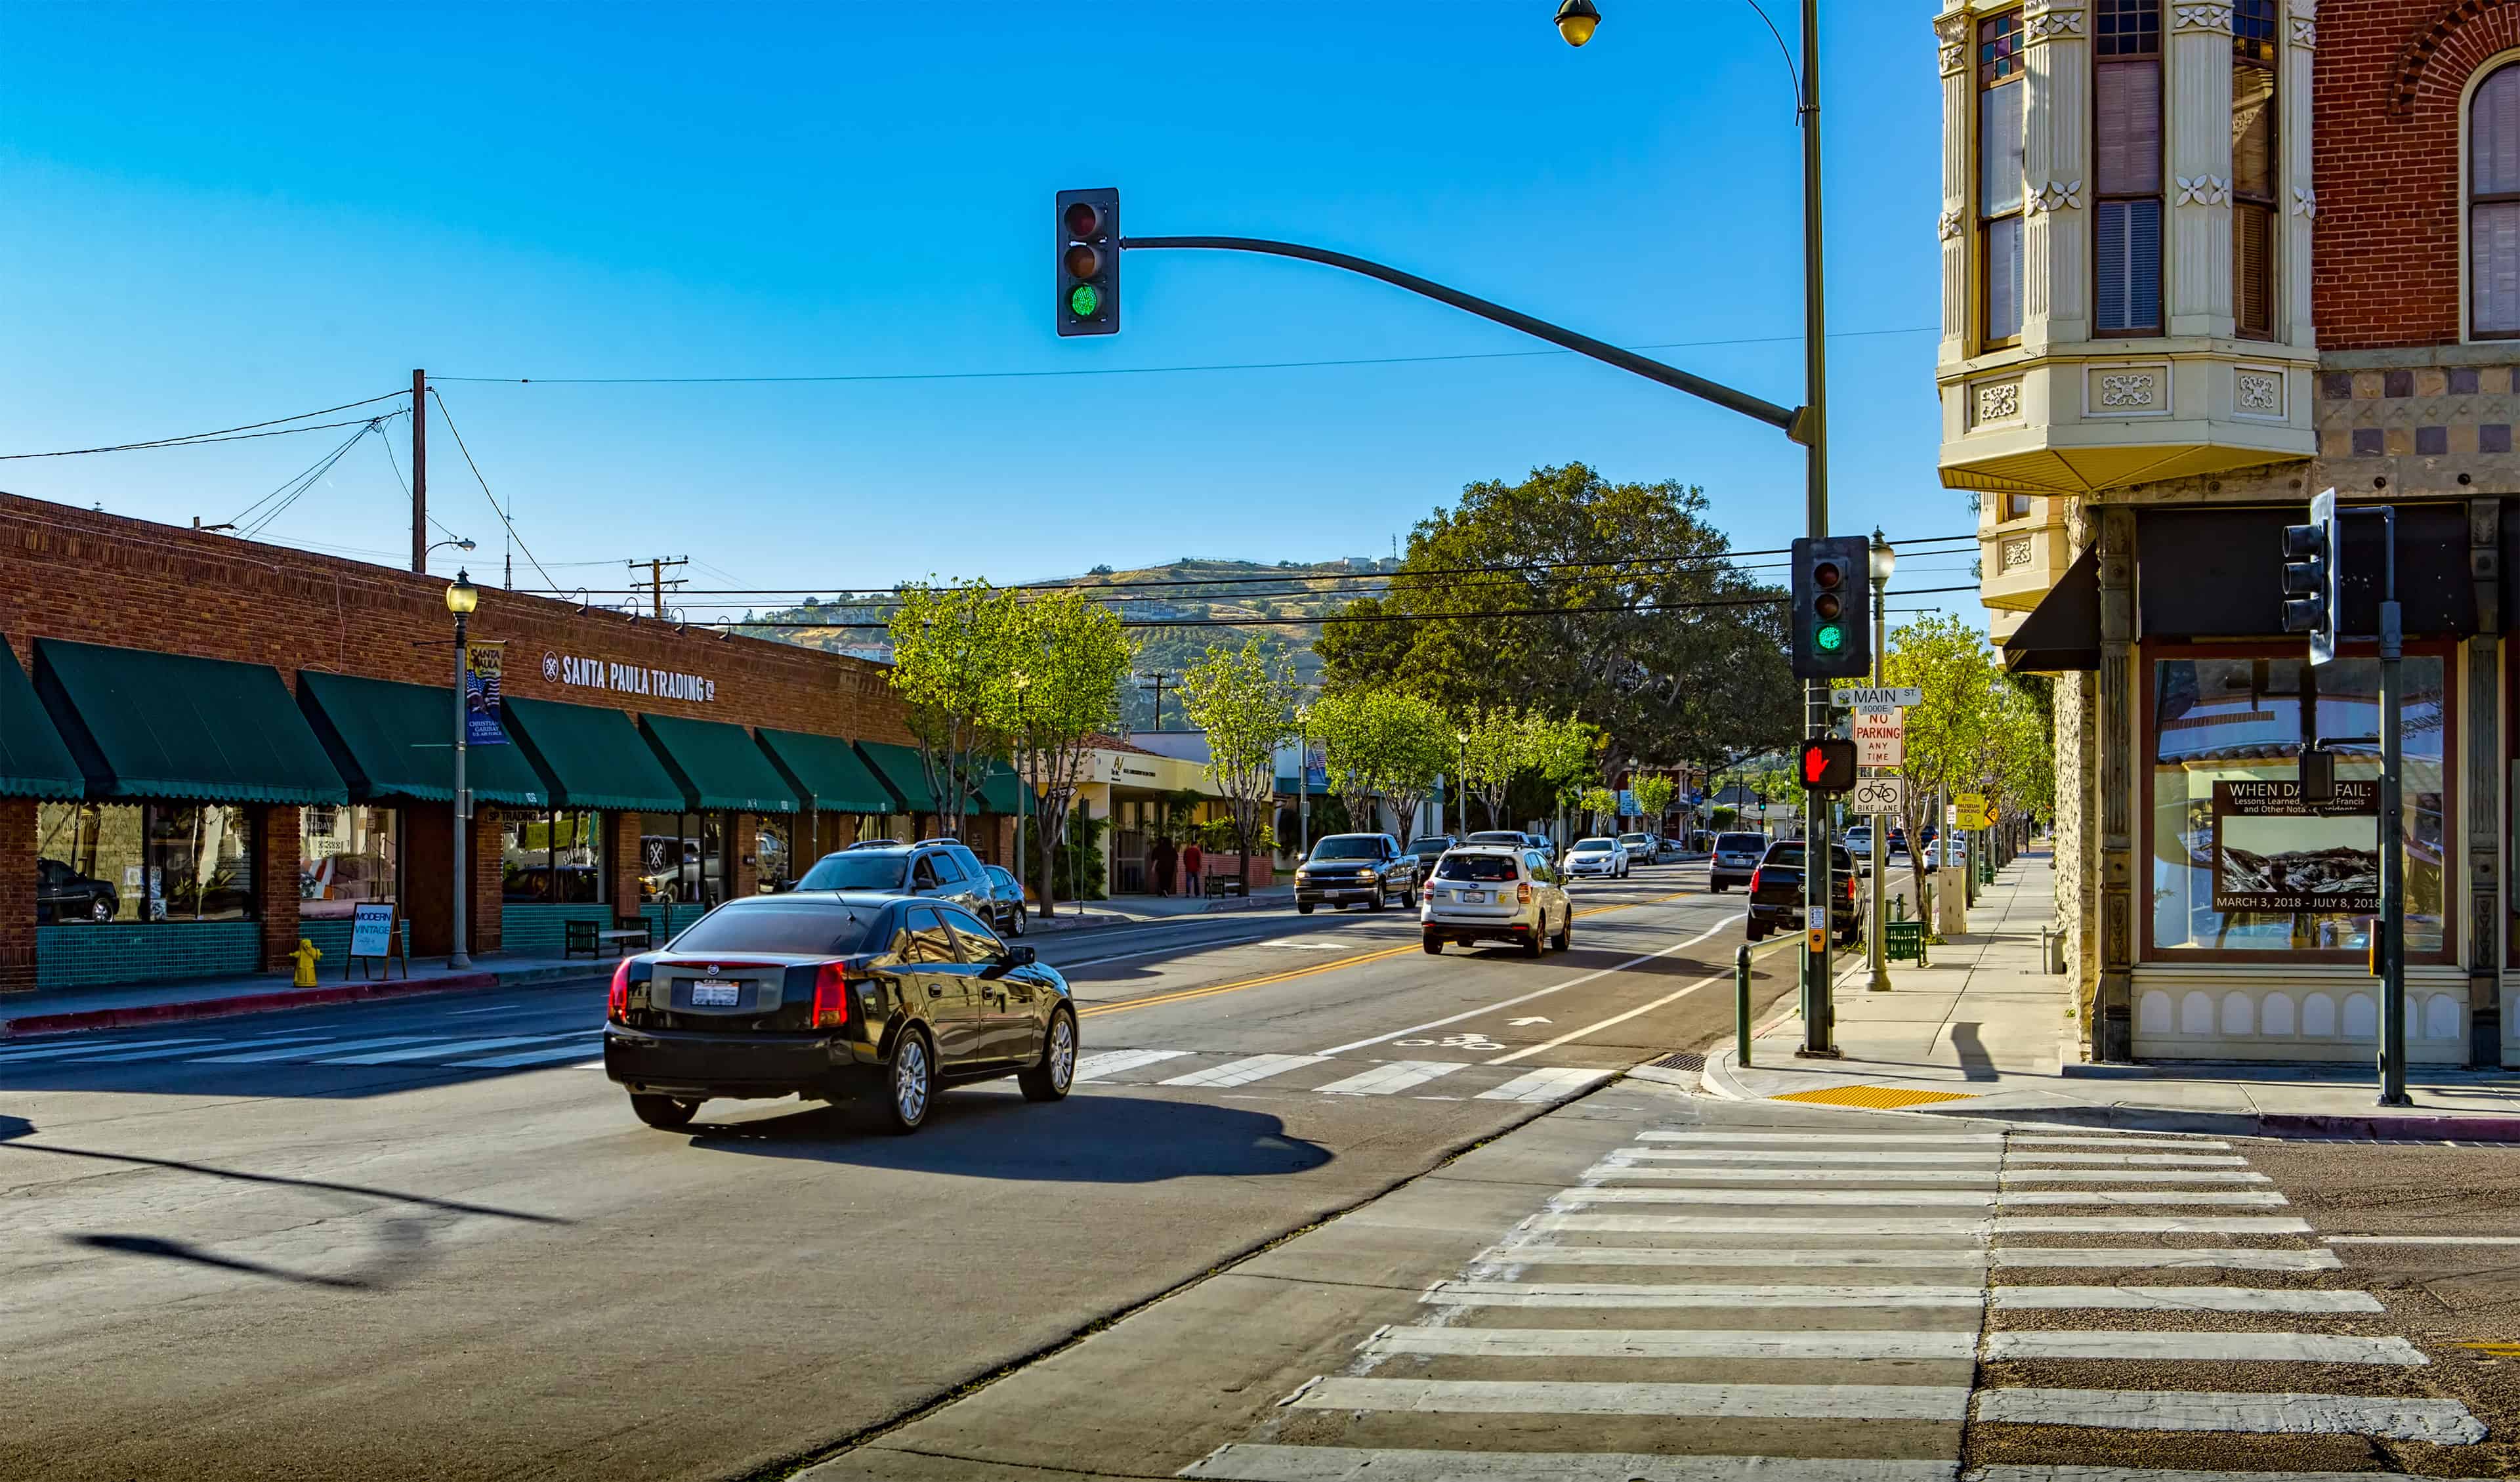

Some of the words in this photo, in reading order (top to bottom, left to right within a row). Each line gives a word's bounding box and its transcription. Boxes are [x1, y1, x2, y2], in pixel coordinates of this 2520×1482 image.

[471, 649, 499, 659] SANTA
[562, 656, 605, 688] SANTA
[609, 663, 649, 695] PAULA
[651, 669, 704, 702] TRADING
[1855, 690, 1896, 704] MAIN
[1869, 714, 1888, 724] NO
[1857, 727, 1900, 739] PARKING
[2229, 783, 2277, 797] WHEN
[2335, 783, 2371, 797] FAIL:
[501, 811, 537, 821] TRADING
[2216, 897, 2257, 907] MARCH
[2261, 897, 2271, 908] 3,
[2274, 897, 2301, 907] 2018
[2312, 897, 2336, 908] JULY
[2340, 897, 2351, 909] 8,
[2353, 897, 2382, 908] 2018
[356, 912, 392, 921] MODERN
[354, 925, 390, 935] VINTAGE
